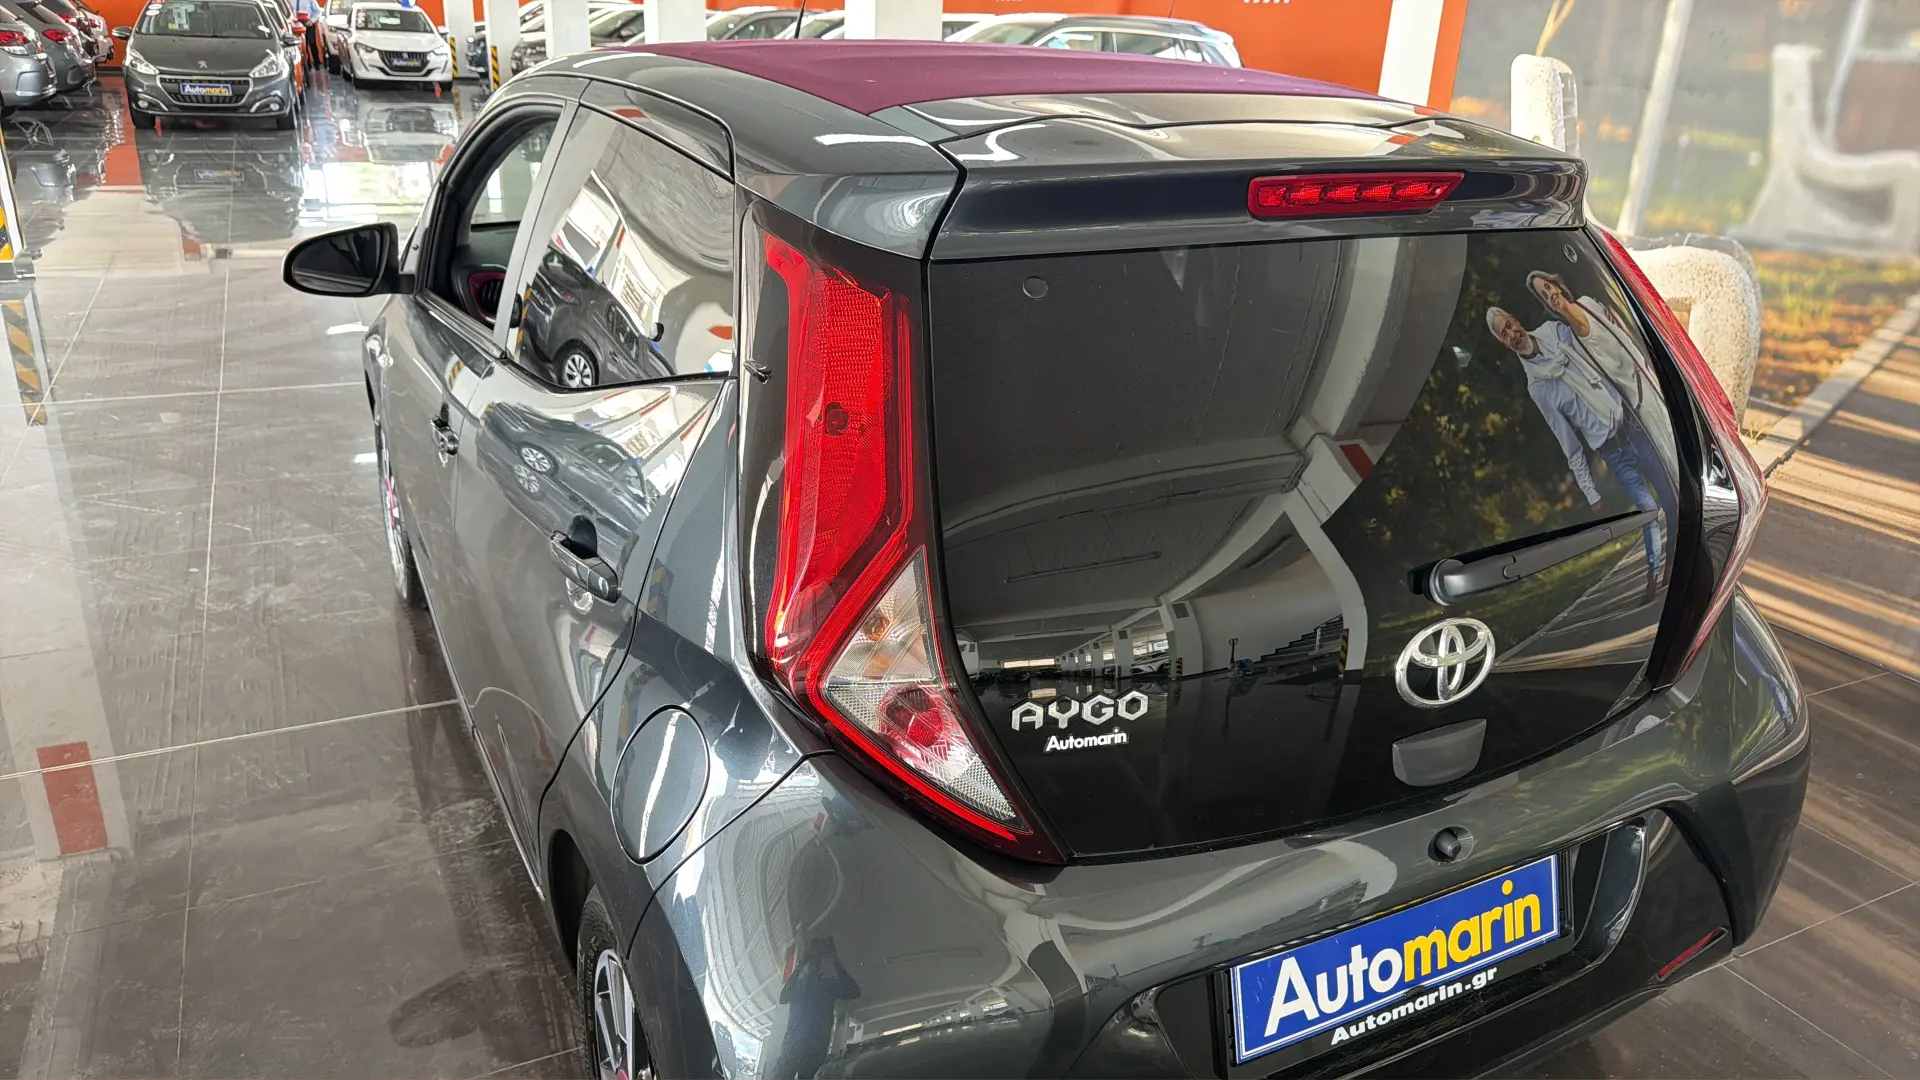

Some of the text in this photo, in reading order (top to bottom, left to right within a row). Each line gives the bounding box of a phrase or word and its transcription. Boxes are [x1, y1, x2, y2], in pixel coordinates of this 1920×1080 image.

[1011, 690, 1149, 731] AYGO
[1045, 728, 1128, 752] Automarin
[1264, 879, 1541, 1038] Automarin
[1331, 967, 1497, 1045] Automarin.gr
